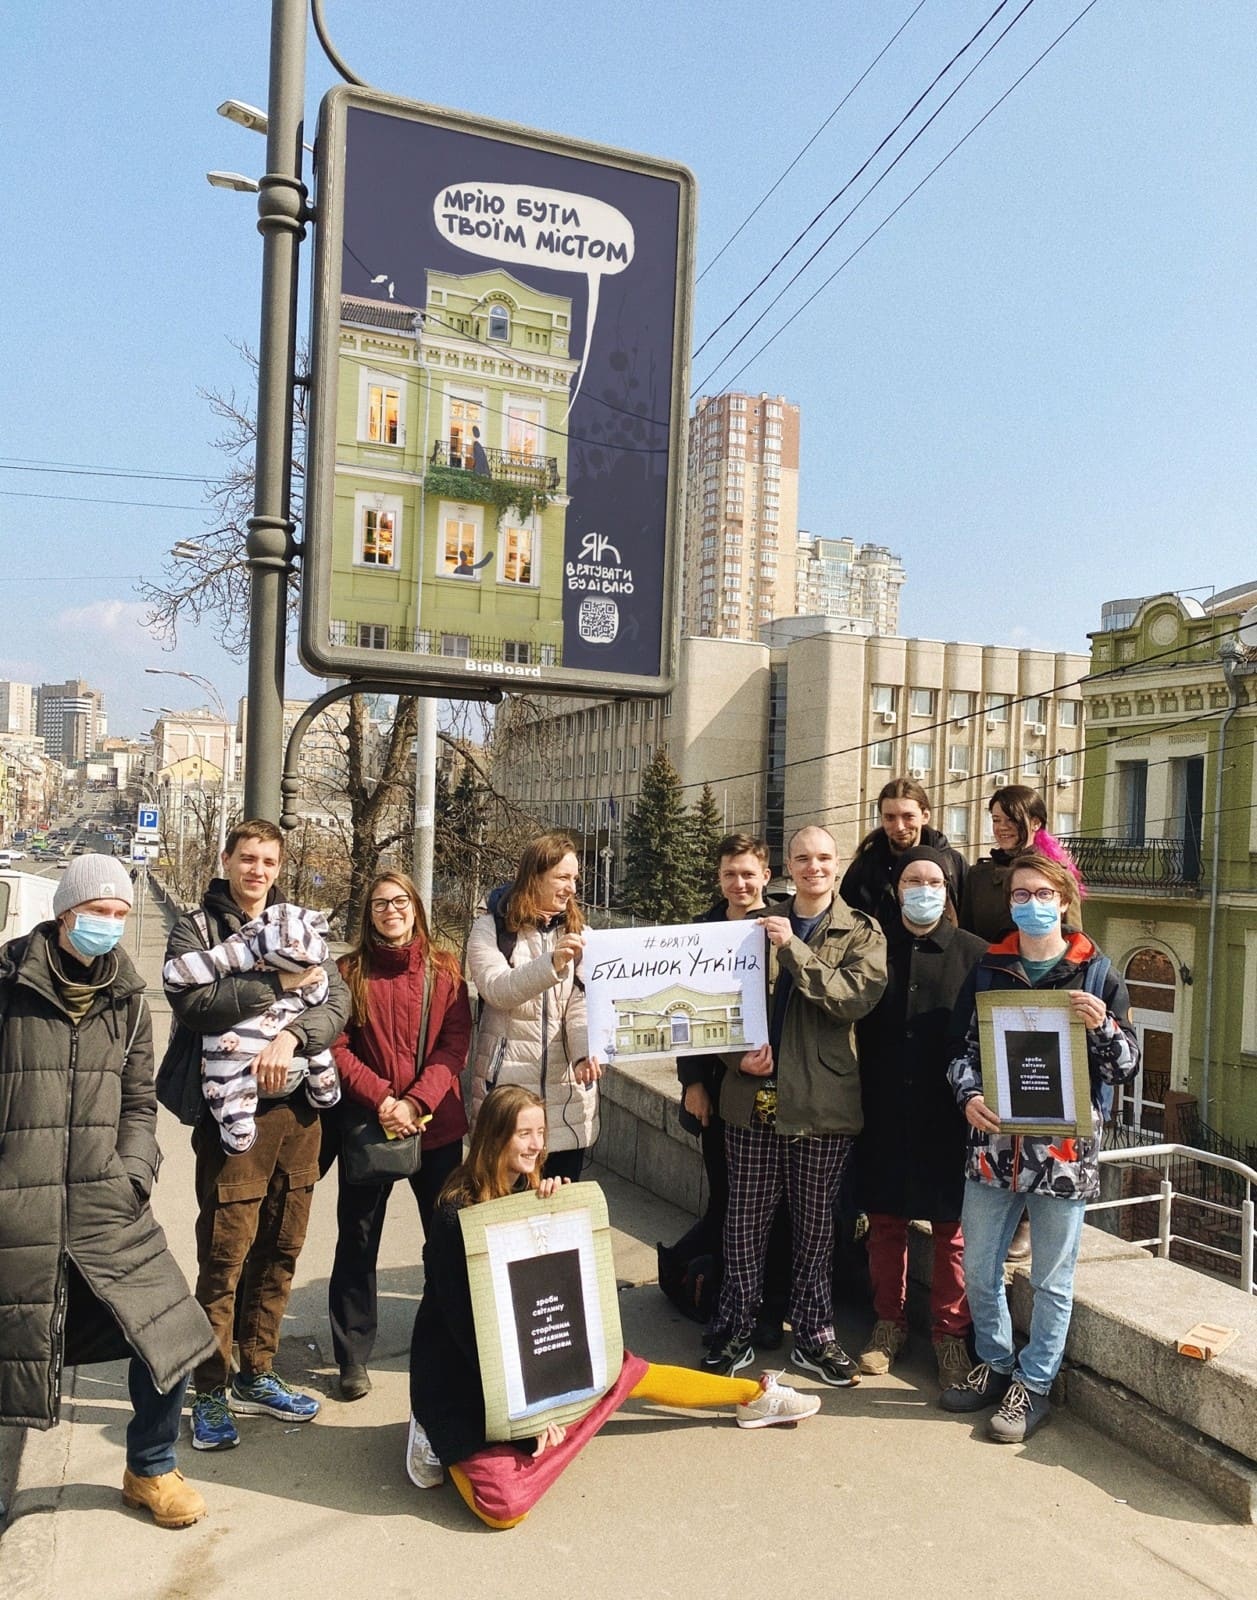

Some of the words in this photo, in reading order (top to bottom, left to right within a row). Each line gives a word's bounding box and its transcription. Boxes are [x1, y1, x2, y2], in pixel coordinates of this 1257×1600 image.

[444, 189, 505, 214] МРІЮ
[517, 199, 580, 227] БУТИ
[442, 213, 526, 248] ТВОЇМ
[536, 229, 628, 264] МІСТОМ
[578, 532, 621, 564] ЯК
[566, 562, 632, 581] ВРЯТУВАТИ
[568, 577, 634, 594] БУДІВЛЮ
[465, 660, 541, 677] BigBoard
[144, 812, 154, 826] P
